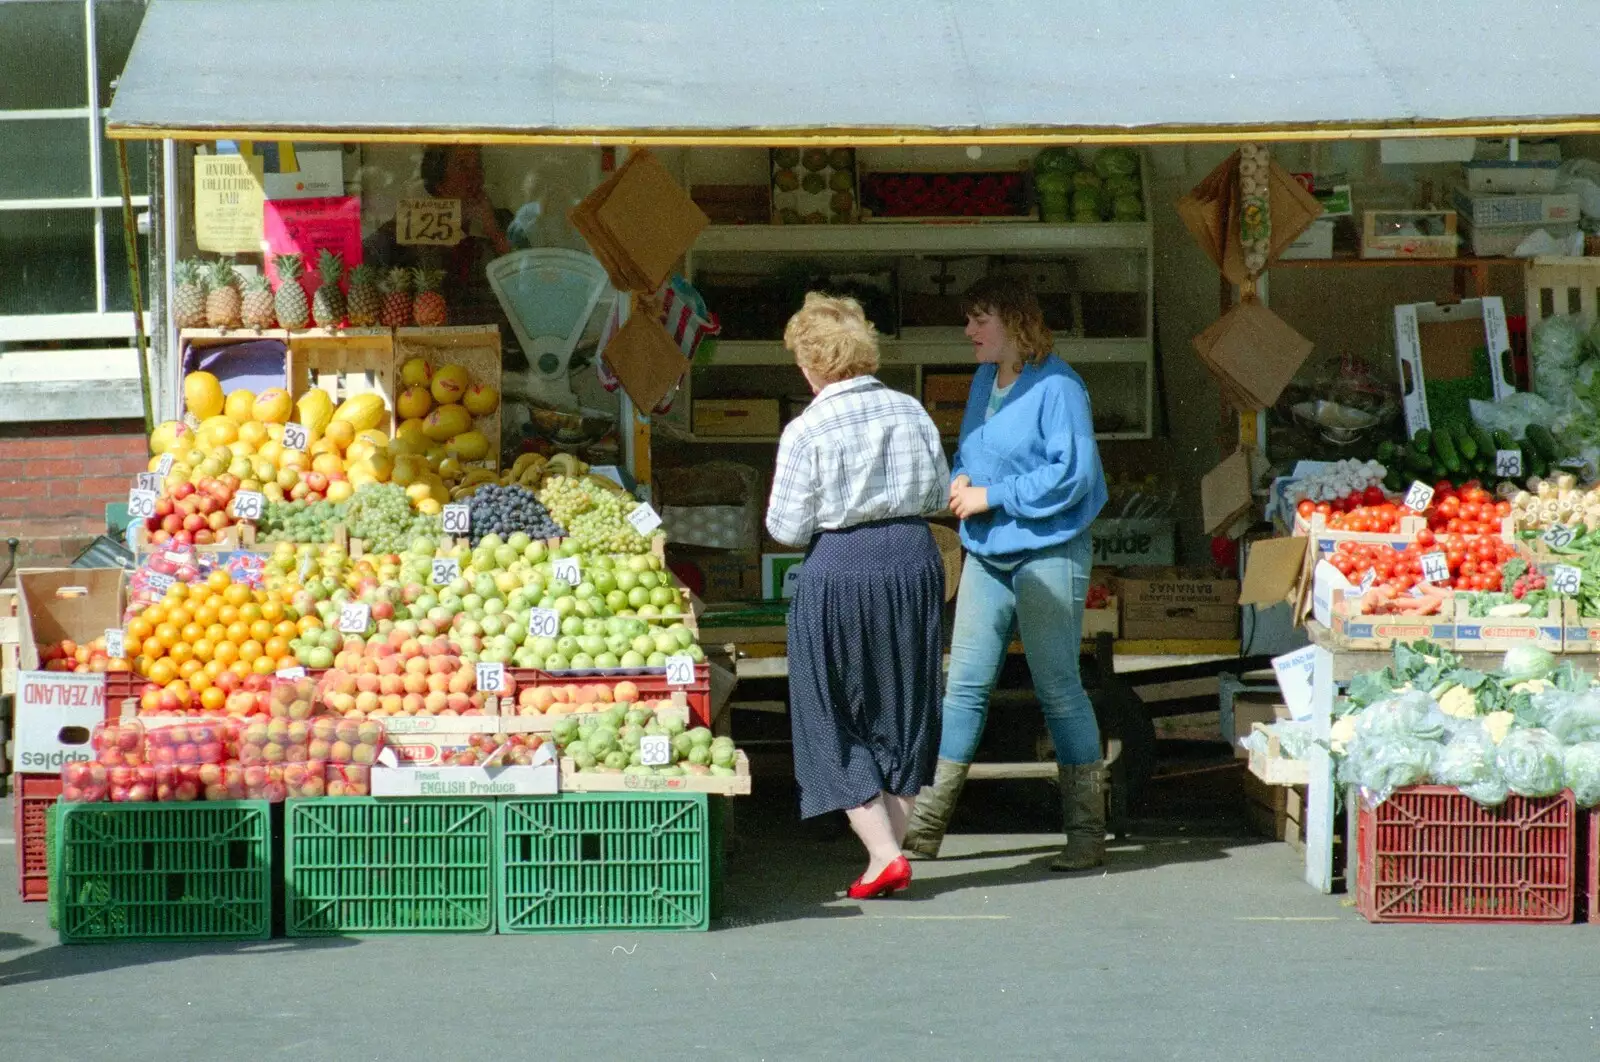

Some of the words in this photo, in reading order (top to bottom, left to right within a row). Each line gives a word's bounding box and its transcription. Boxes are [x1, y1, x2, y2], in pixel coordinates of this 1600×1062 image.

[283, 428, 305, 449] 30
[1498, 456, 1519, 476] 48
[130, 497, 152, 515] 30
[235, 496, 258, 517] 48
[1406, 485, 1430, 511] 38
[444, 511, 467, 530] 80
[1544, 524, 1571, 547] 30
[433, 563, 457, 584] 36
[1425, 560, 1447, 580] 44
[1149, 583, 1213, 594] BANANAS
[1555, 574, 1578, 594] 48
[340, 609, 363, 630] 36
[531, 615, 555, 635] 30
[480, 669, 499, 690] 15
[667, 662, 691, 681] 20
[25, 684, 88, 706] ZEALAND
[643, 742, 667, 763] 38
[420, 781, 466, 795] ENGLISH
[470, 780, 516, 794] Produce
